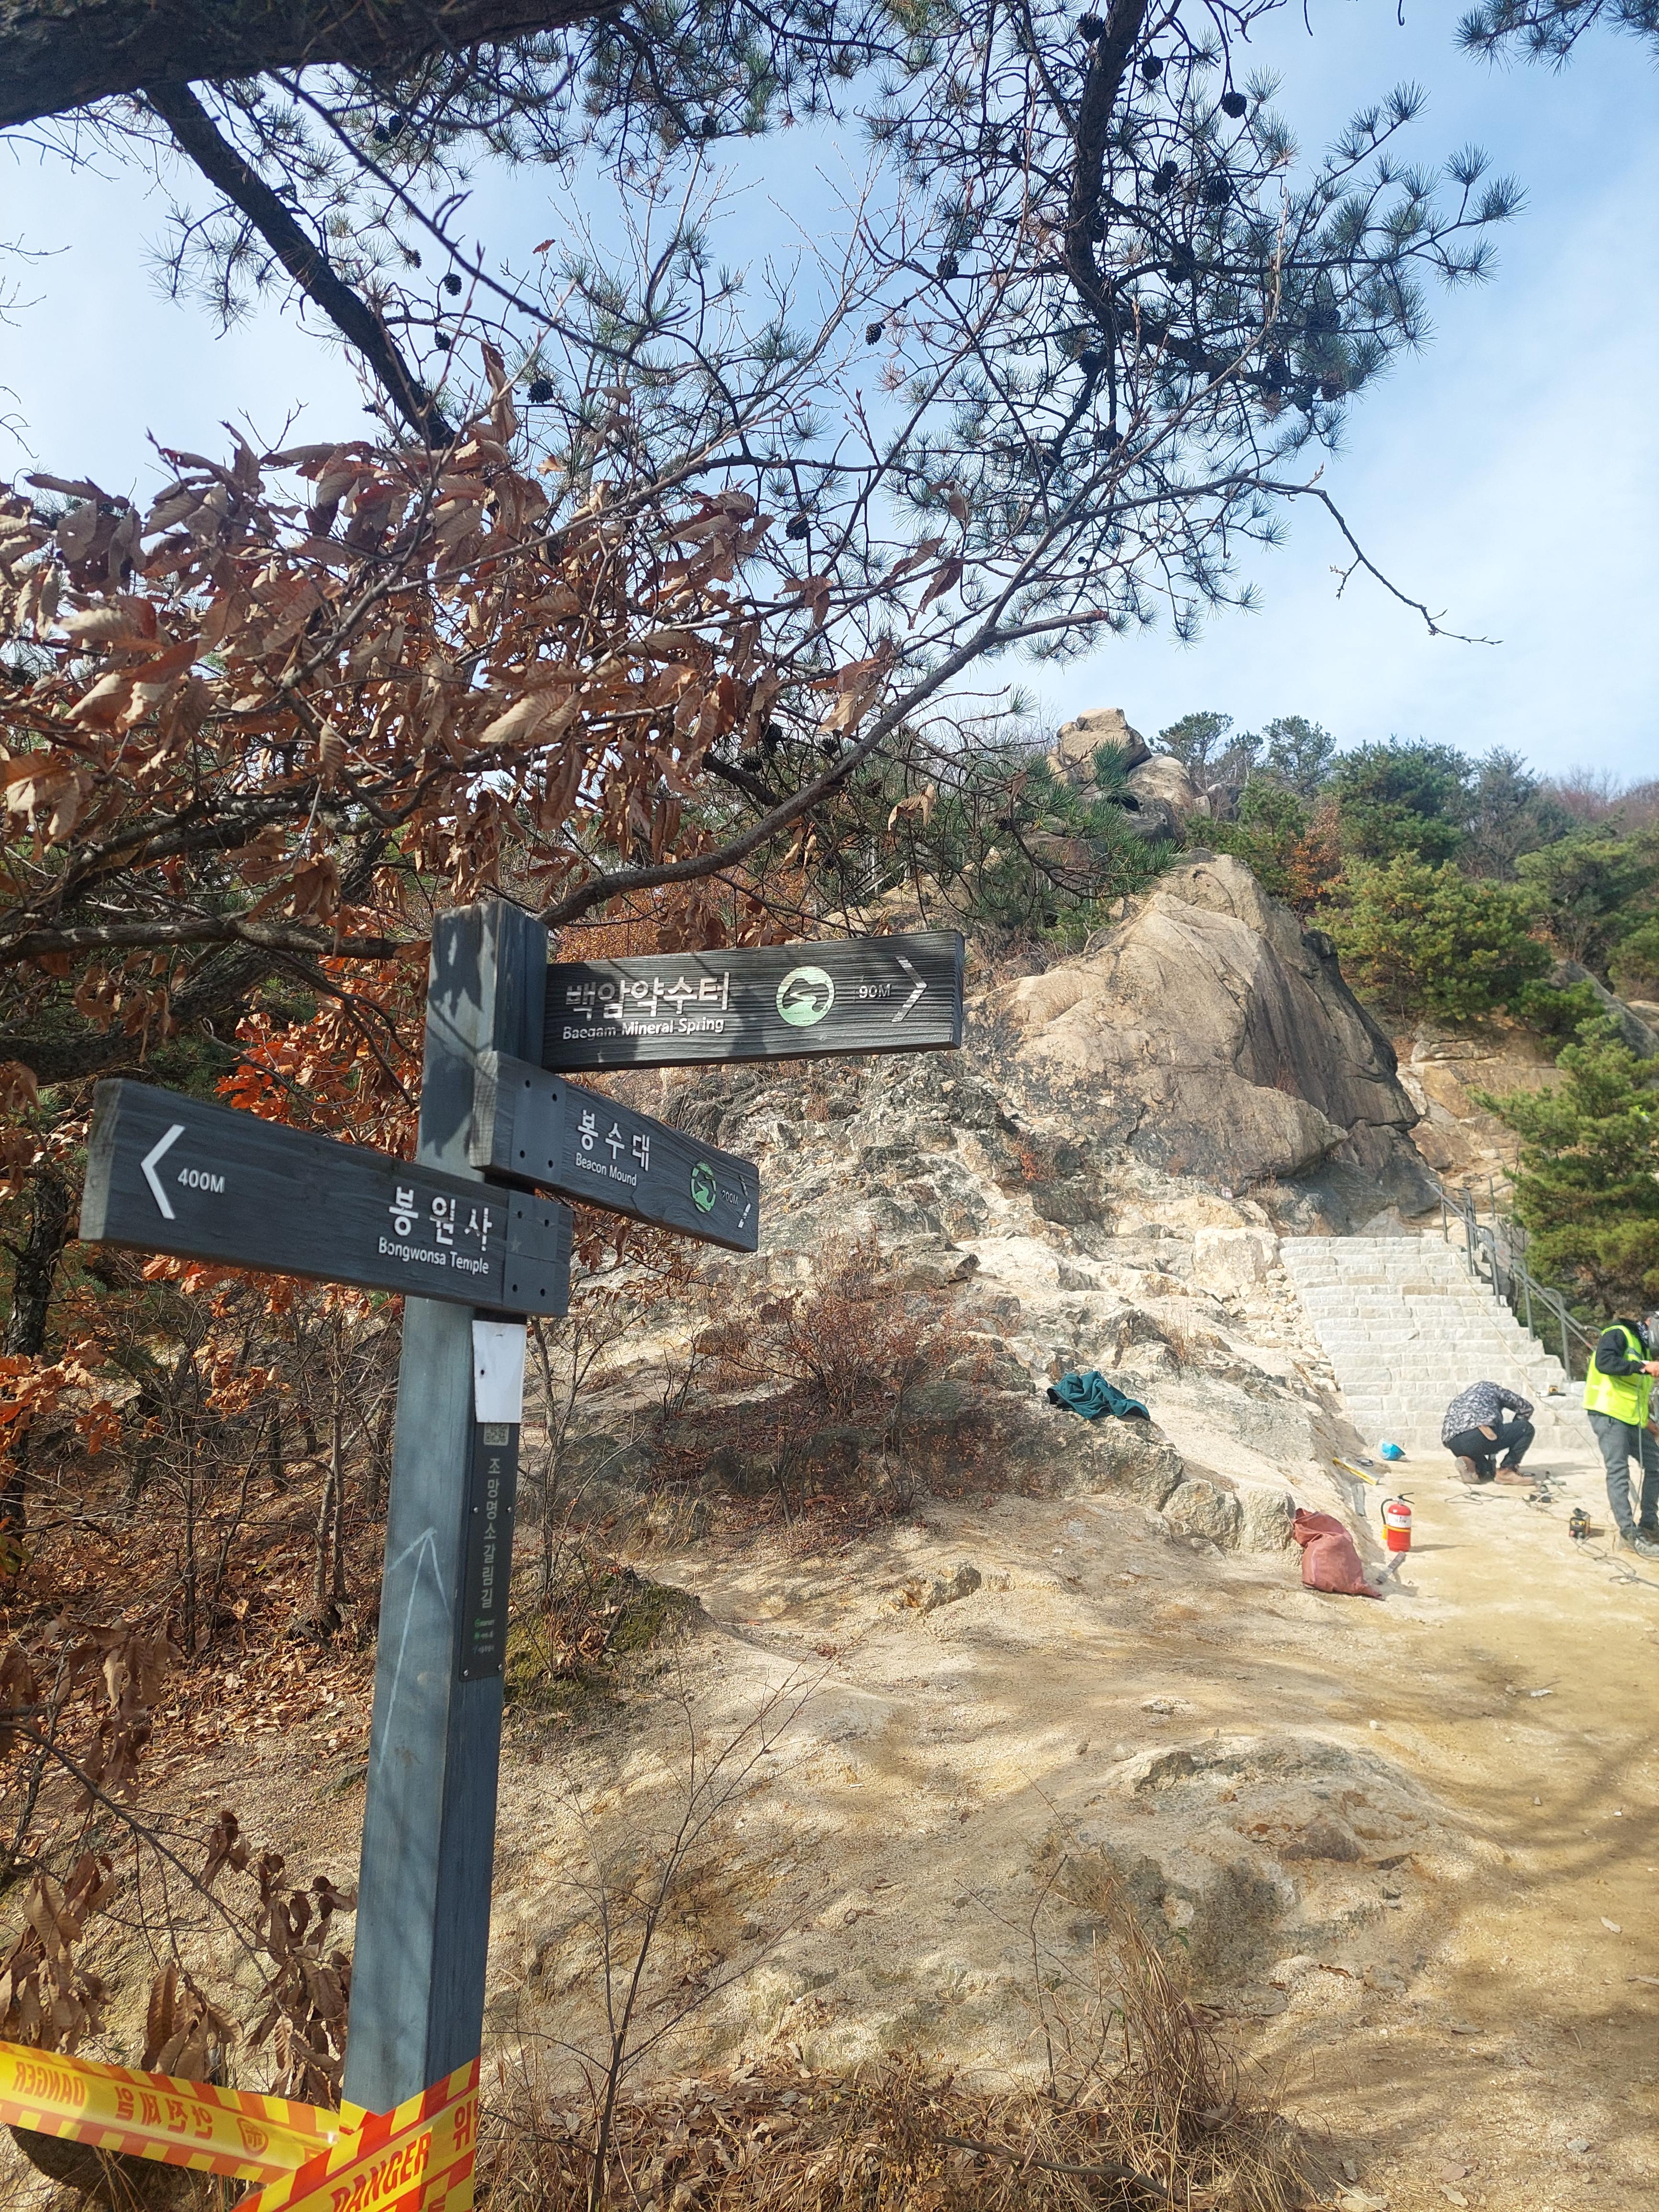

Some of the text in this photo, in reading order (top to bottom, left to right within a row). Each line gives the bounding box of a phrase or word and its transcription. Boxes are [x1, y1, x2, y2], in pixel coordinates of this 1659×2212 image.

[565, 972, 730, 1021] 백암약수터
[859, 984, 891, 998] 90M
[563, 1017, 724, 1041] Baegam Mineral Spring
[577, 1109, 650, 1172] 봉수대
[177, 1168, 225, 1193] 400M
[575, 1152, 638, 1186] Beacon Mound
[388, 1186, 493, 1251] 봉원사
[378, 1236, 489, 1275] Bongwonsa Temple
[453, 2097, 478, 2151] 위
[331, 2132, 431, 2212] DANGER
